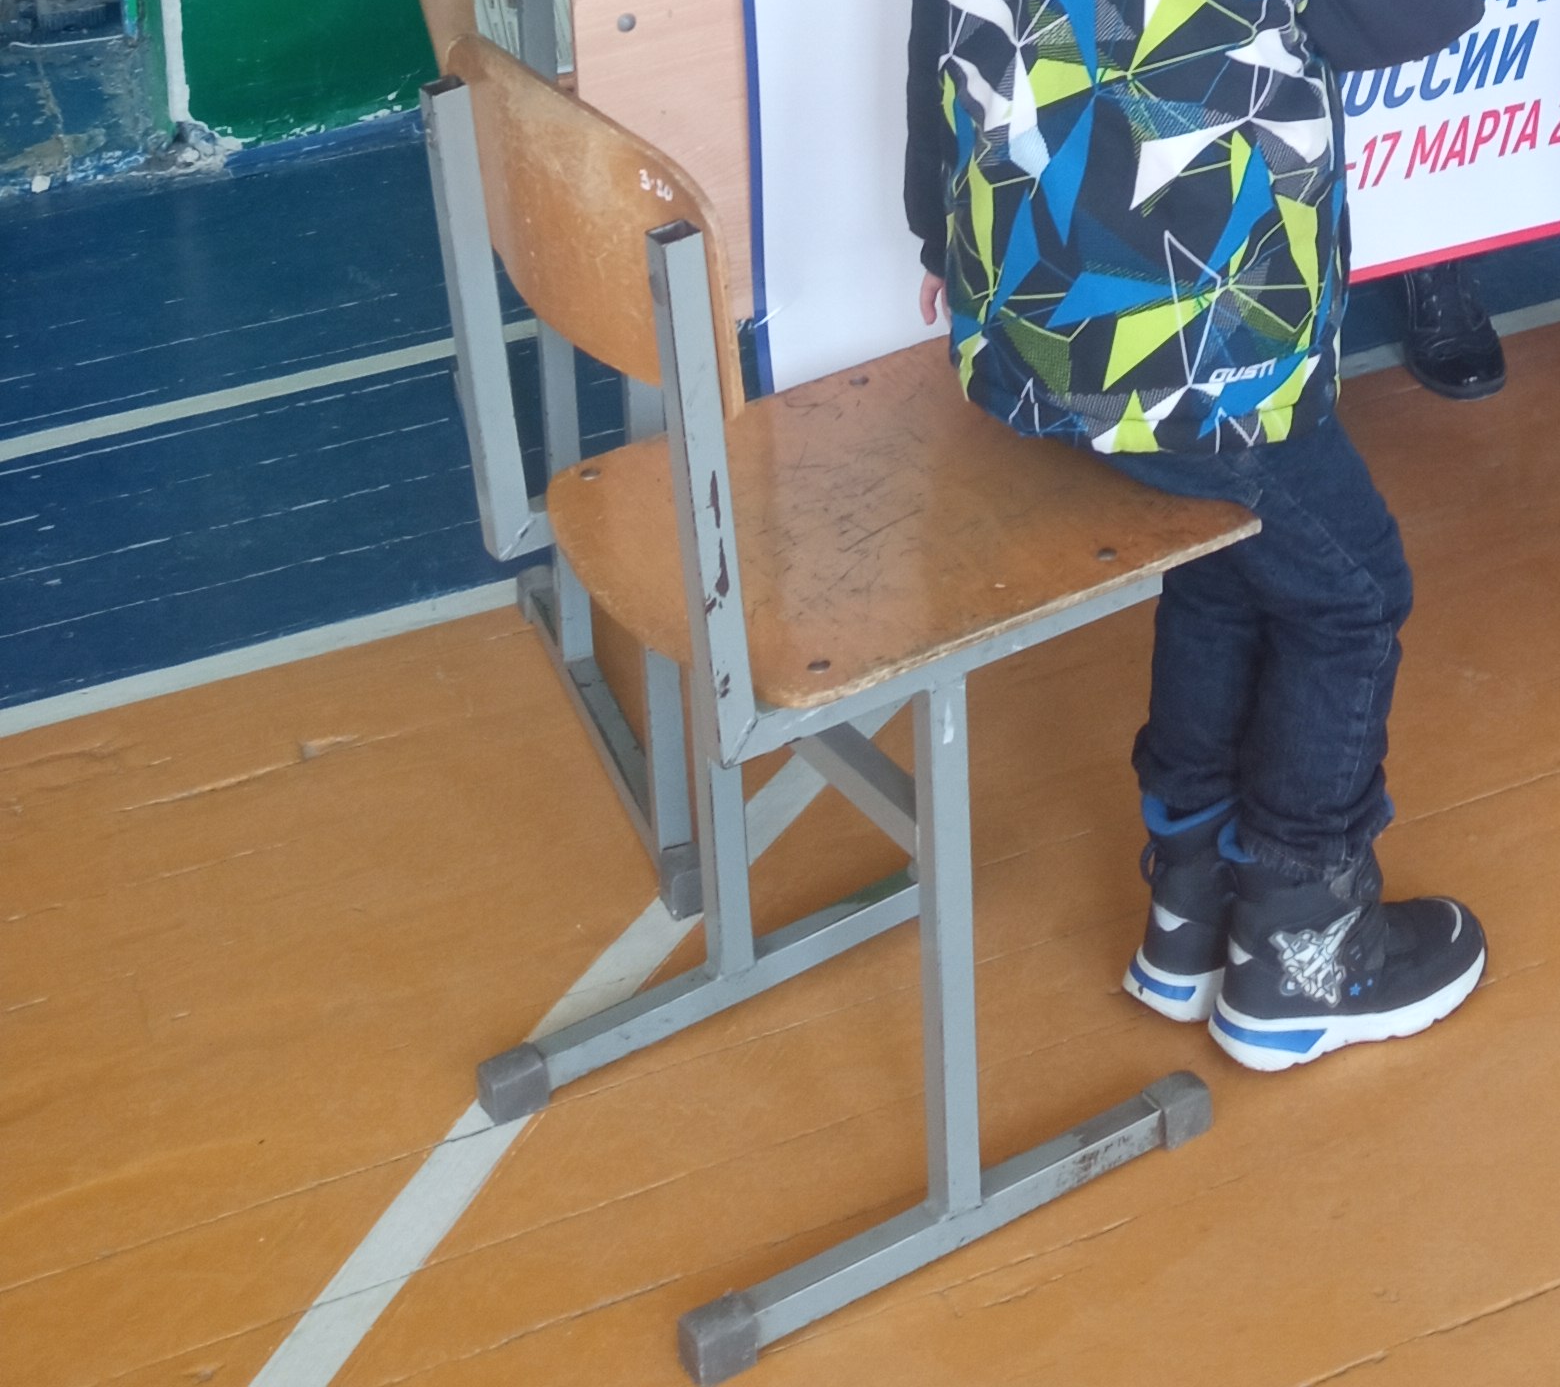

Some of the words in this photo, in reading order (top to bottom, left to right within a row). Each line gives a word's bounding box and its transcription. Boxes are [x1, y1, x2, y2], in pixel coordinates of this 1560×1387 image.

[1340, 19, 1540, 117] ОССИИ
[1345, 130, 1402, 190] -17
[1404, 99, 1541, 179] МАРТА
